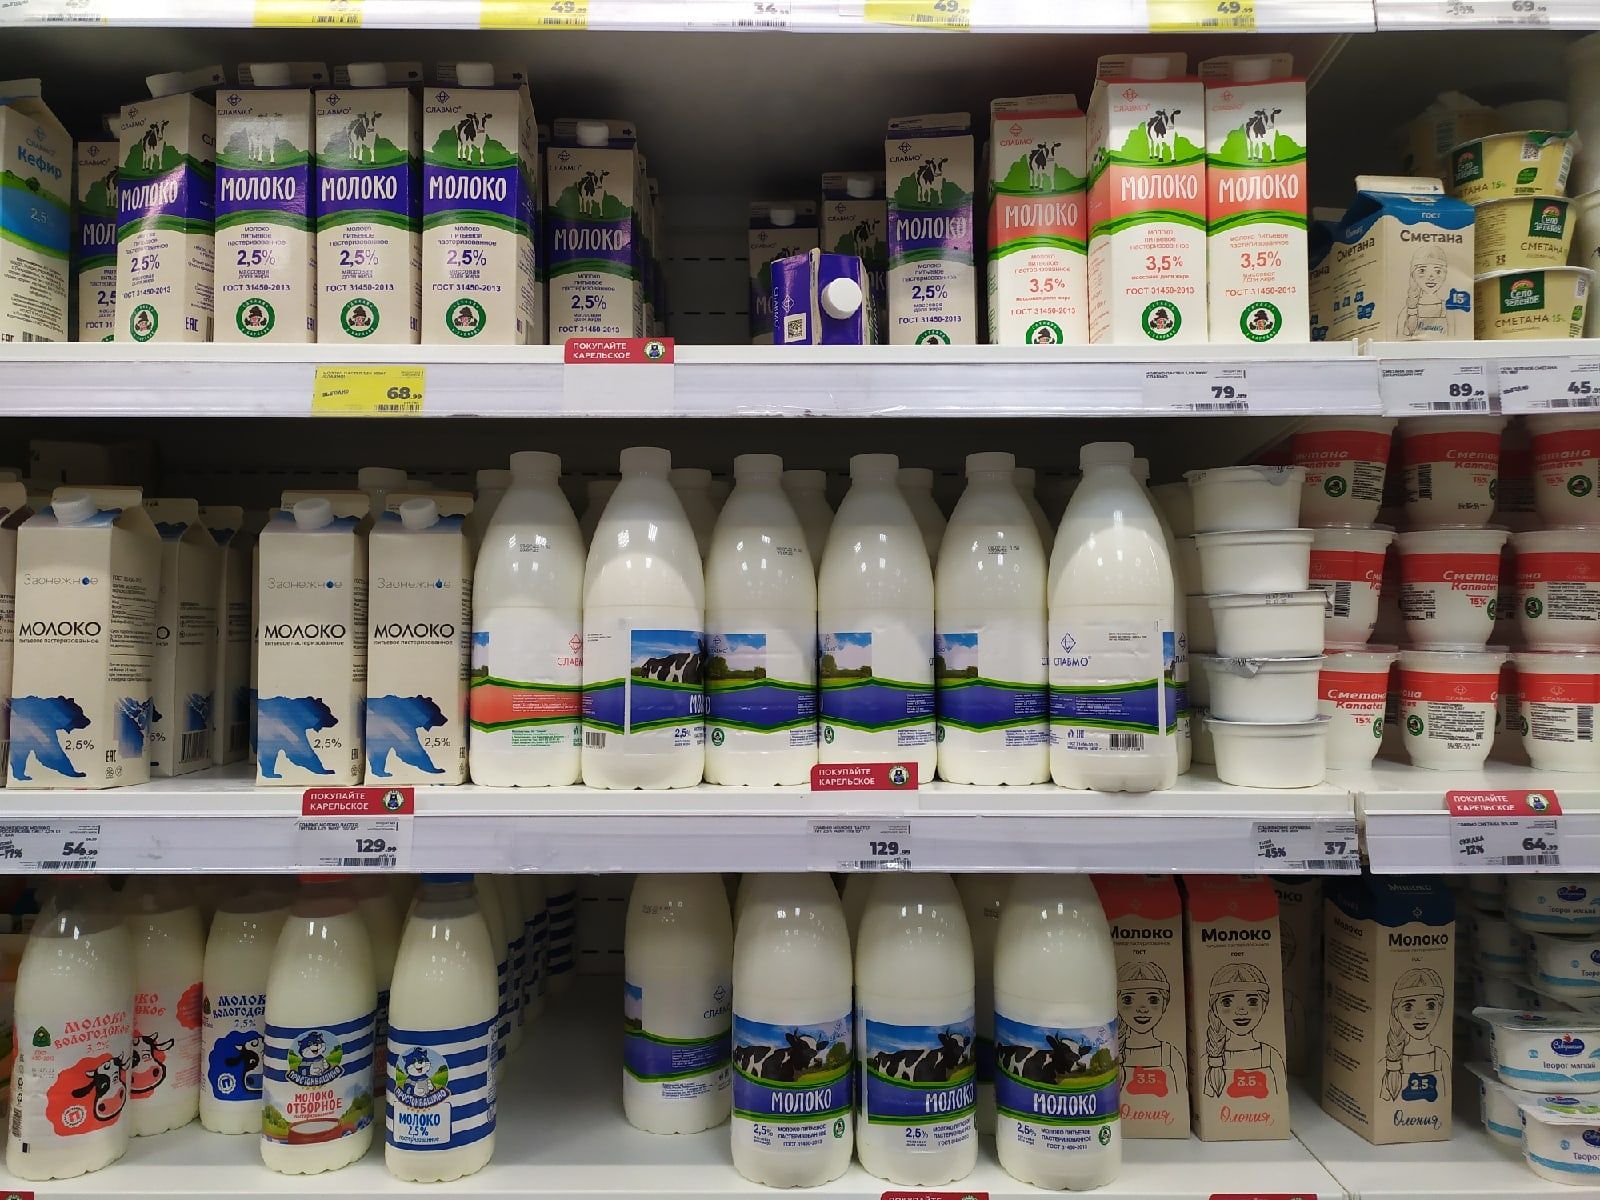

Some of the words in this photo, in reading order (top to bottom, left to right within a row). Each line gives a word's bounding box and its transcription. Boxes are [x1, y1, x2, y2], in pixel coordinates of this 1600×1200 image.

[18, 148, 62, 180] Кефир
[221, 176, 295, 201] МОЛОКО
[322, 176, 397, 201] МОЛОКО
[429, 176, 506, 201] МОЛОКО
[1121, 173, 1198, 201] МОЛОКО
[1218, 174, 1299, 203] МОЛОКО
[121, 180, 179, 212] МОЛОКО
[1005, 204, 1077, 228] МОЛОКО
[896, 216, 967, 241] МОЛОКО
[554, 228, 623, 251] МОЛОКО
[1400, 230, 1463, 244] Сметана
[1337, 238, 1375, 260] Сметана
[1521, 242, 1562, 253] СМЕТАНА
[237, 249, 275, 267] 2,5%
[340, 249, 379, 267] 2,5%
[447, 249, 487, 267] 2,5%
[1145, 255, 1183, 273] 3,5%
[912, 284, 948, 301] 2,5%
[571, 295, 607, 310] 2,5%
[1495, 314, 1549, 328] СМЕТАНА
[573, 342, 626, 350] ПОКУПАЙТЕ
[387, 387, 422, 400] 68.99
[1211, 386, 1247, 399] 79.99
[1449, 383, 1484, 397] 89.99
[1470, 597, 1486, 605] 15%
[19, 621, 102, 637] МОЛОКО
[264, 623, 346, 639] МОЛОКО
[373, 623, 455, 638] МОЛОКО
[314, 737, 342, 749] 2,5%
[424, 736, 450, 748] 2,5%
[818, 767, 871, 776] ПОКУПАЙТЕ
[818, 777, 875, 786] КАРЕЛЬСКОЕ
[310, 791, 366, 800] ПОКУПАЙТЕ
[310, 802, 369, 810] КАРЕЛЬСКОЕ
[62, 842, 98, 856] 54.99
[356, 839, 397, 853] 129.99
[869, 841, 911, 855] 129.99
[1460, 844, 1484, 855] -12%
[1522, 838, 1558, 850] 64.99
[1258, 847, 1287, 858] -45%
[1110, 926, 1173, 939] Молоко
[1201, 928, 1272, 942] Молоко
[1388, 933, 1449, 947] Молоко
[295, 1090, 334, 1102] МОЛОКО
[771, 1088, 832, 1113] МОЛОКО
[925, 1083, 974, 1112] МОЛОКО
[287, 1098, 343, 1114] ОТБОРНОЕ
[1033, 1093, 1097, 1115] МОЛОКО
[399, 1112, 441, 1126] МОЛОКО
[753, 1123, 773, 1137] 2,5%
